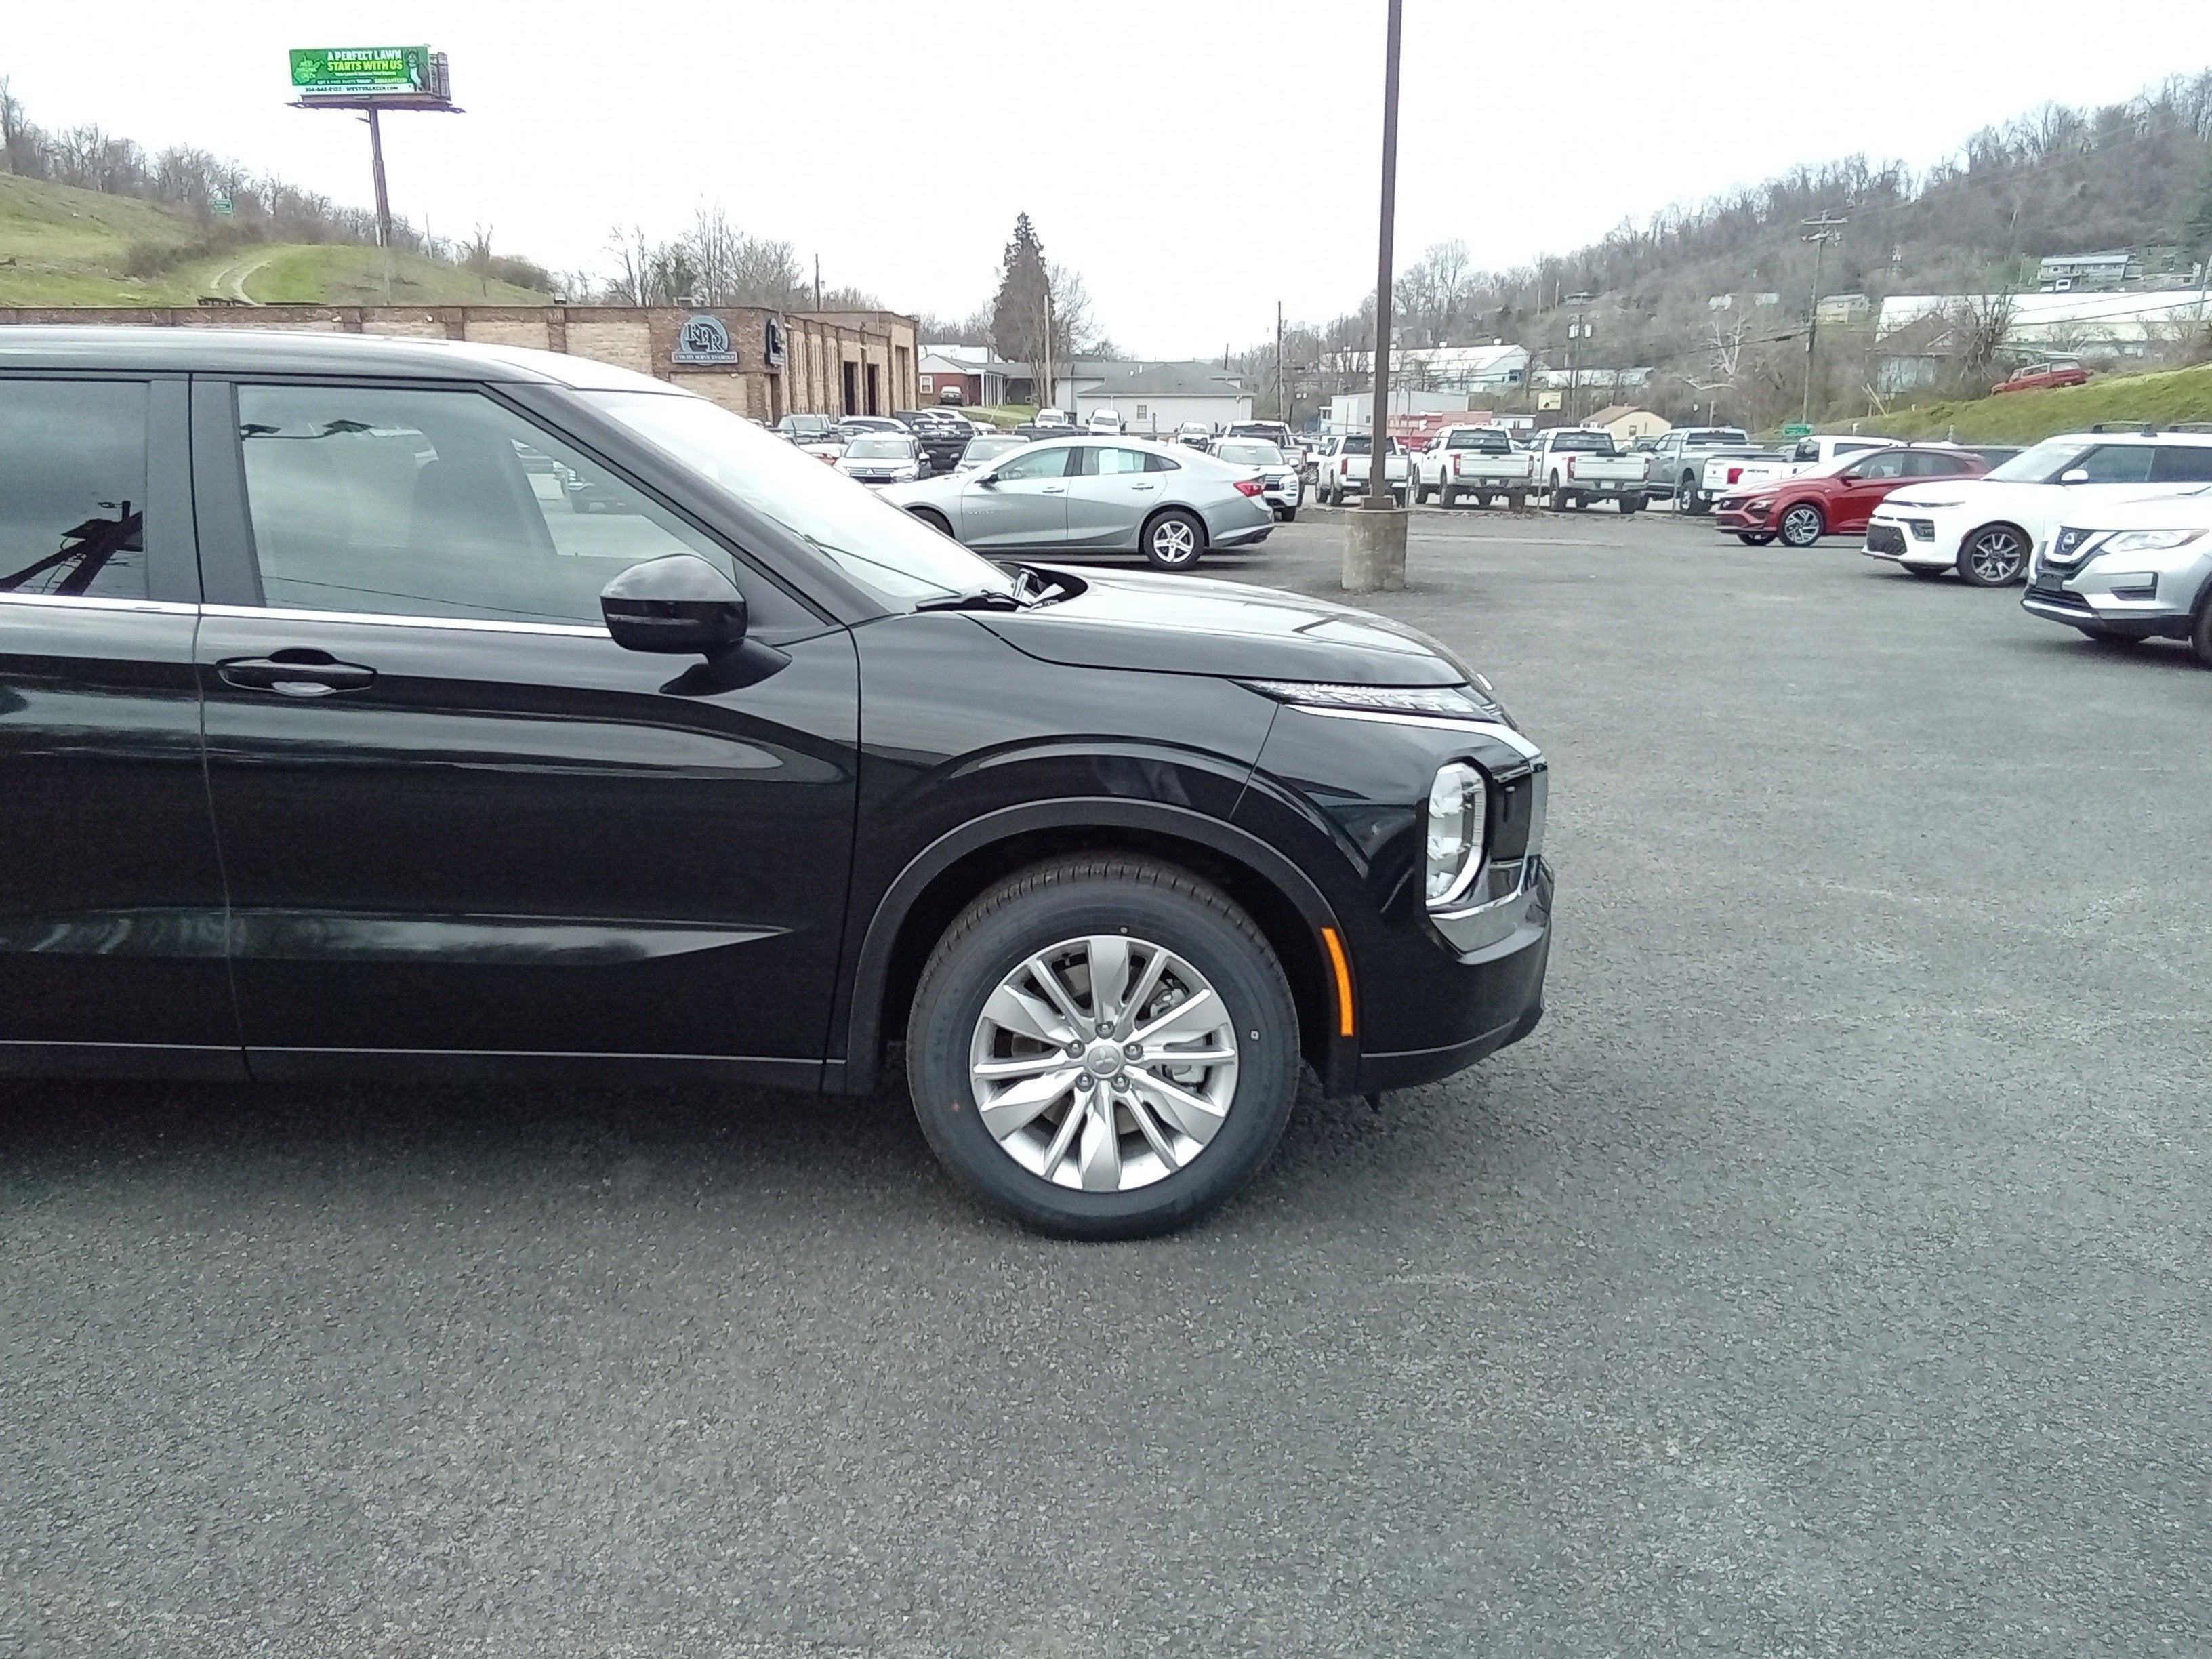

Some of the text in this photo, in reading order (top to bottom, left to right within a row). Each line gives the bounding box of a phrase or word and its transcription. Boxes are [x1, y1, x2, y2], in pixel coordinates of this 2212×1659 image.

[327, 49, 402, 61] A PERFECT LAWN
[327, 61, 363, 71] STARTS
[363, 60, 389, 70] WITH
[390, 60, 403, 70] US
